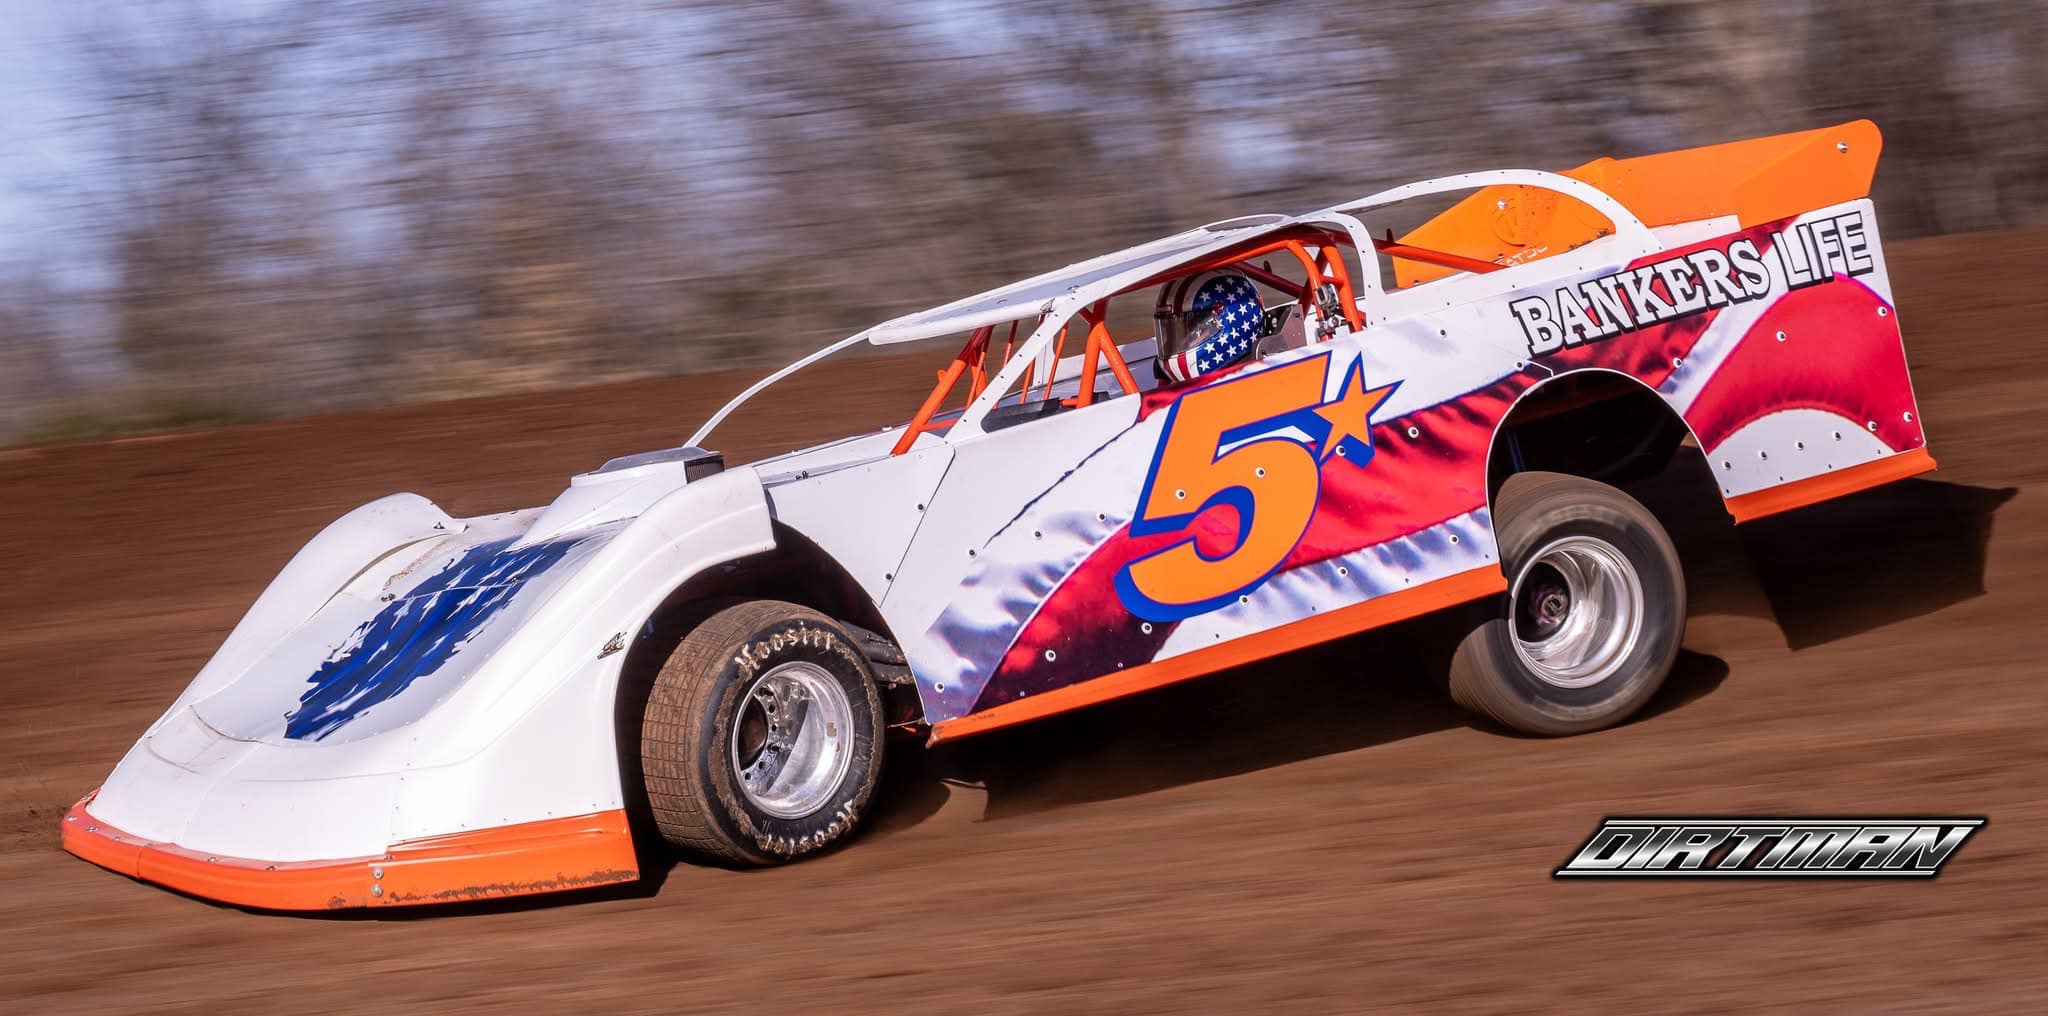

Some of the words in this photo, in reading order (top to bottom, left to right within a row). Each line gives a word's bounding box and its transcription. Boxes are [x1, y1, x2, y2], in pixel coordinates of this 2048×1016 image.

[1509, 238, 1771, 357] BANKERS
[1769, 210, 1874, 292] LIFE
[1113, 350, 1333, 623] 5
